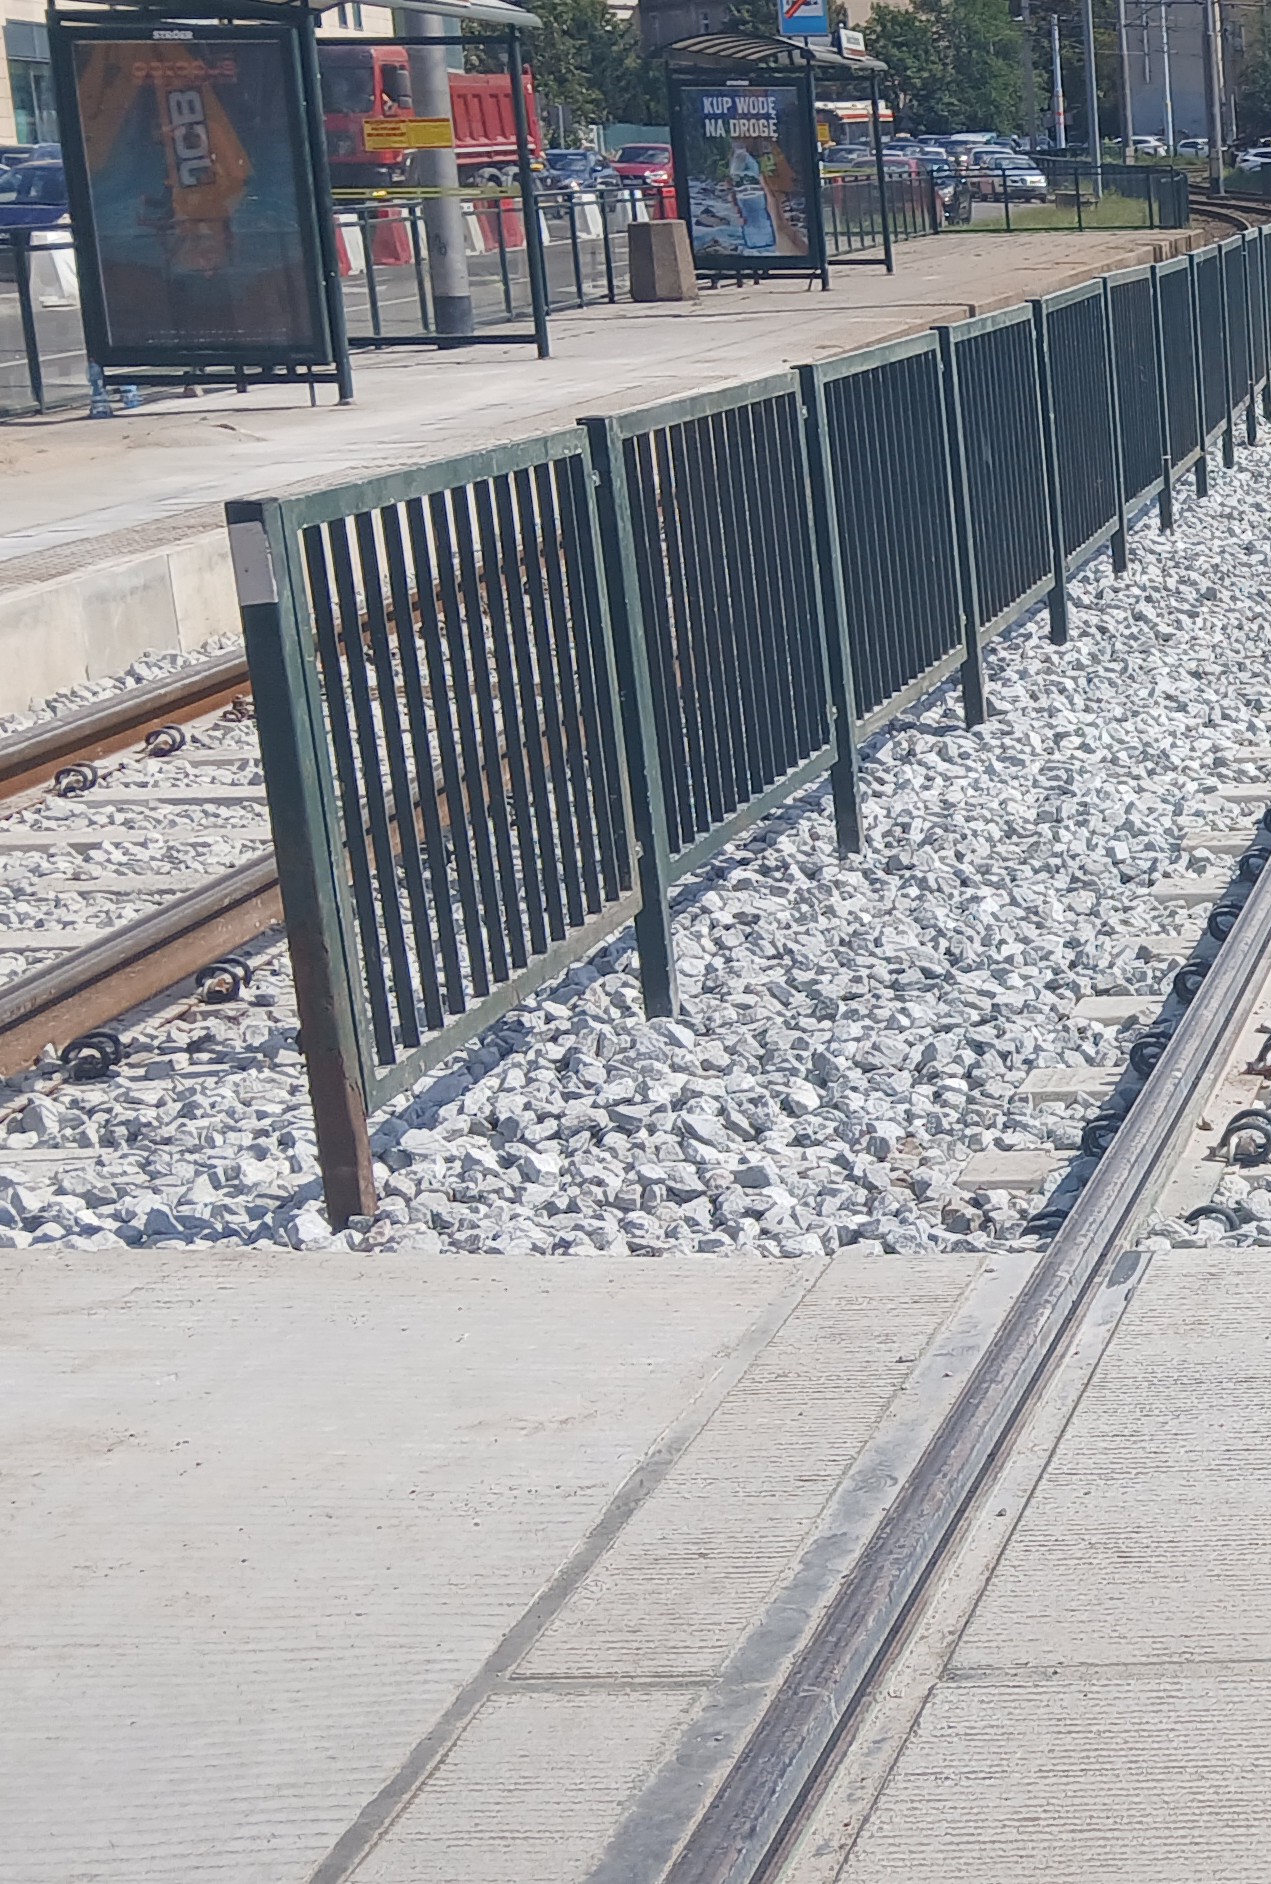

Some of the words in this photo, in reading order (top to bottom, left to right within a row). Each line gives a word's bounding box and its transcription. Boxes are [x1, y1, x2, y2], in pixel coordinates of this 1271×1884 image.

[703, 97, 732, 114] KUP
[735, 96, 777, 118] WODĘ
[168, 90, 212, 186] JCB
[705, 119, 726, 137] NA
[729, 119, 778, 141] DROGĘ
